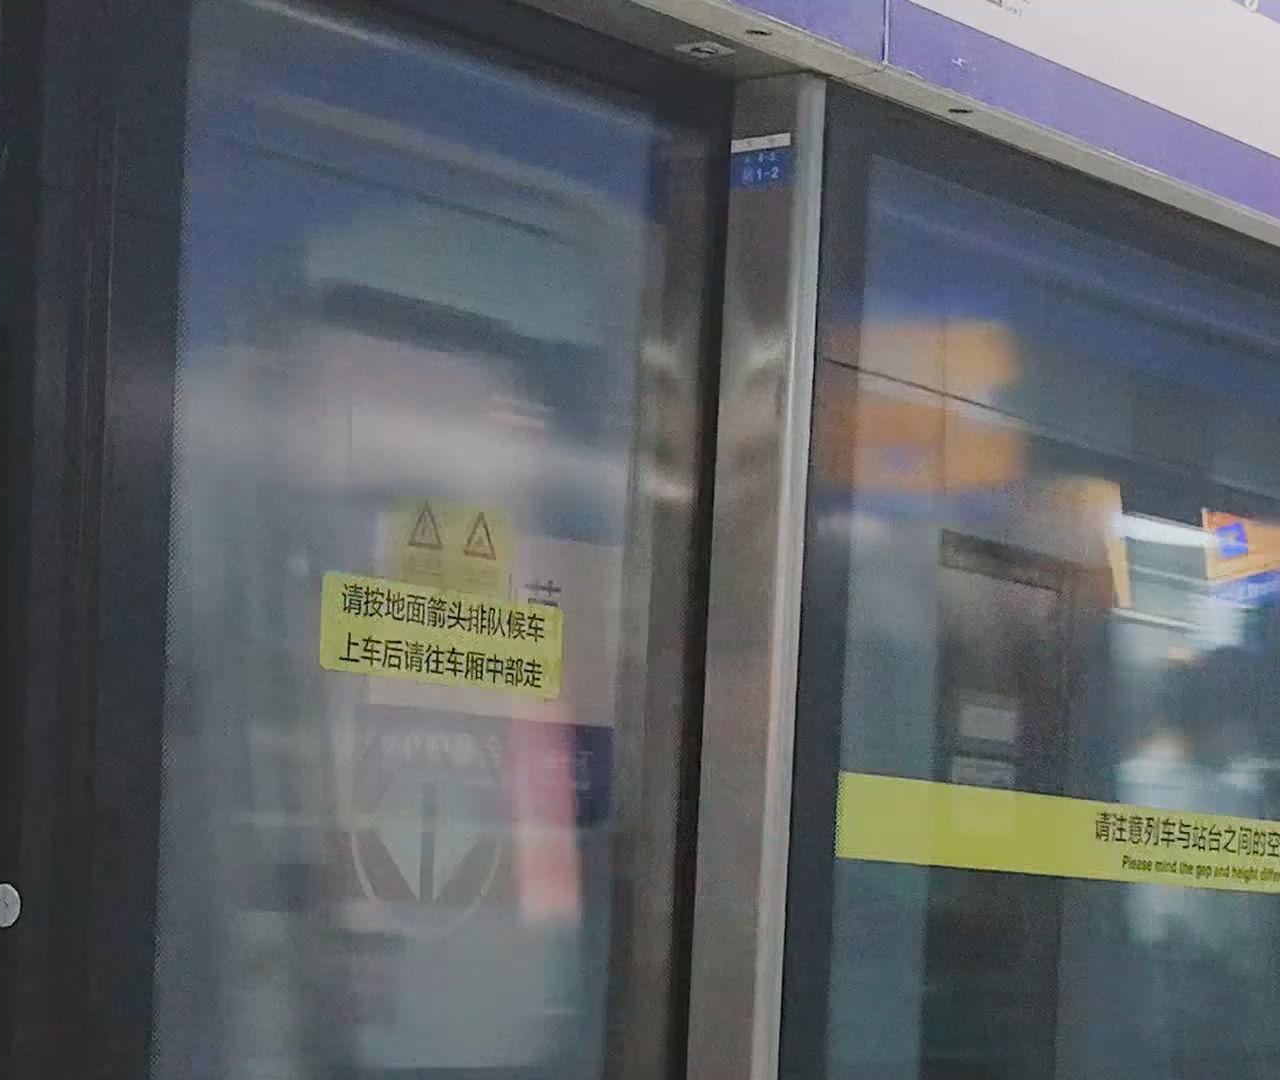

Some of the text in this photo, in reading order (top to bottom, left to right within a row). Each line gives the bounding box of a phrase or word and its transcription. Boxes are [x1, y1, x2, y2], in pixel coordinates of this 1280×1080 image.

[342, 583, 545, 643] 请按地面箭头排队候车
[339, 631, 543, 689] 上车后请往车厢中部走
[1122, 854, 1152, 871] Please
